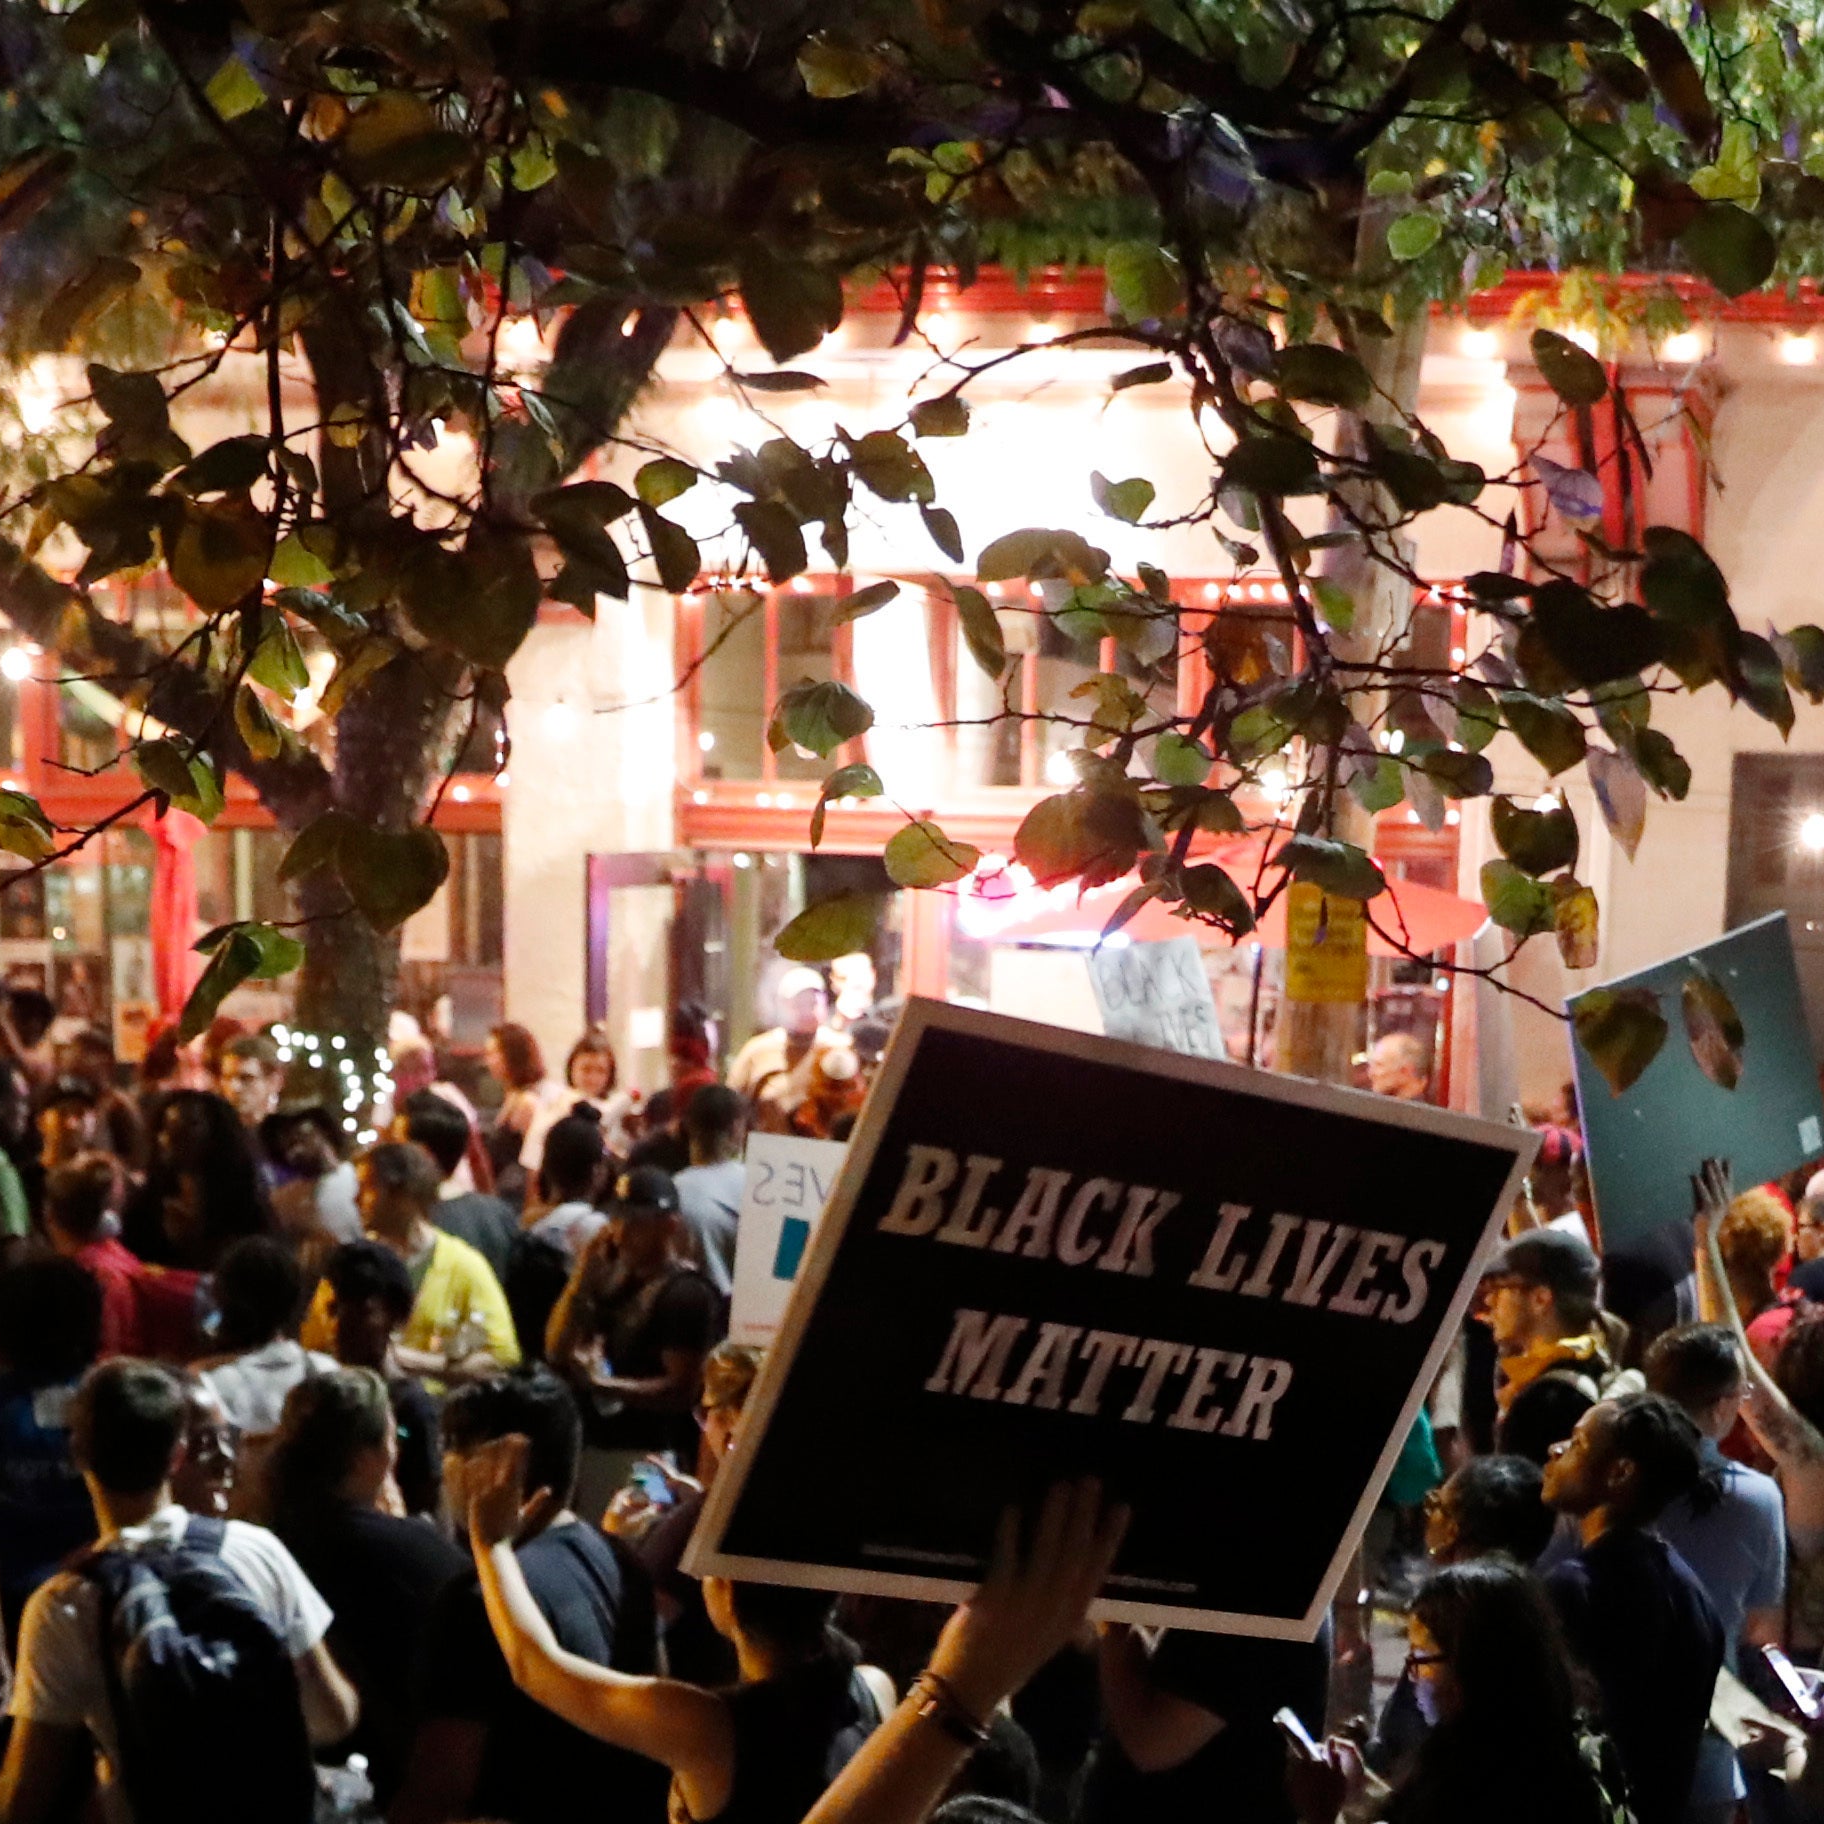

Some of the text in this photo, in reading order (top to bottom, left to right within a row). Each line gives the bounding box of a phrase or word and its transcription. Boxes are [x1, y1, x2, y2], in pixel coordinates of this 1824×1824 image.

[879, 1144, 1447, 1325] BLACK LIVES
[924, 1308, 1295, 1441] MATTER
